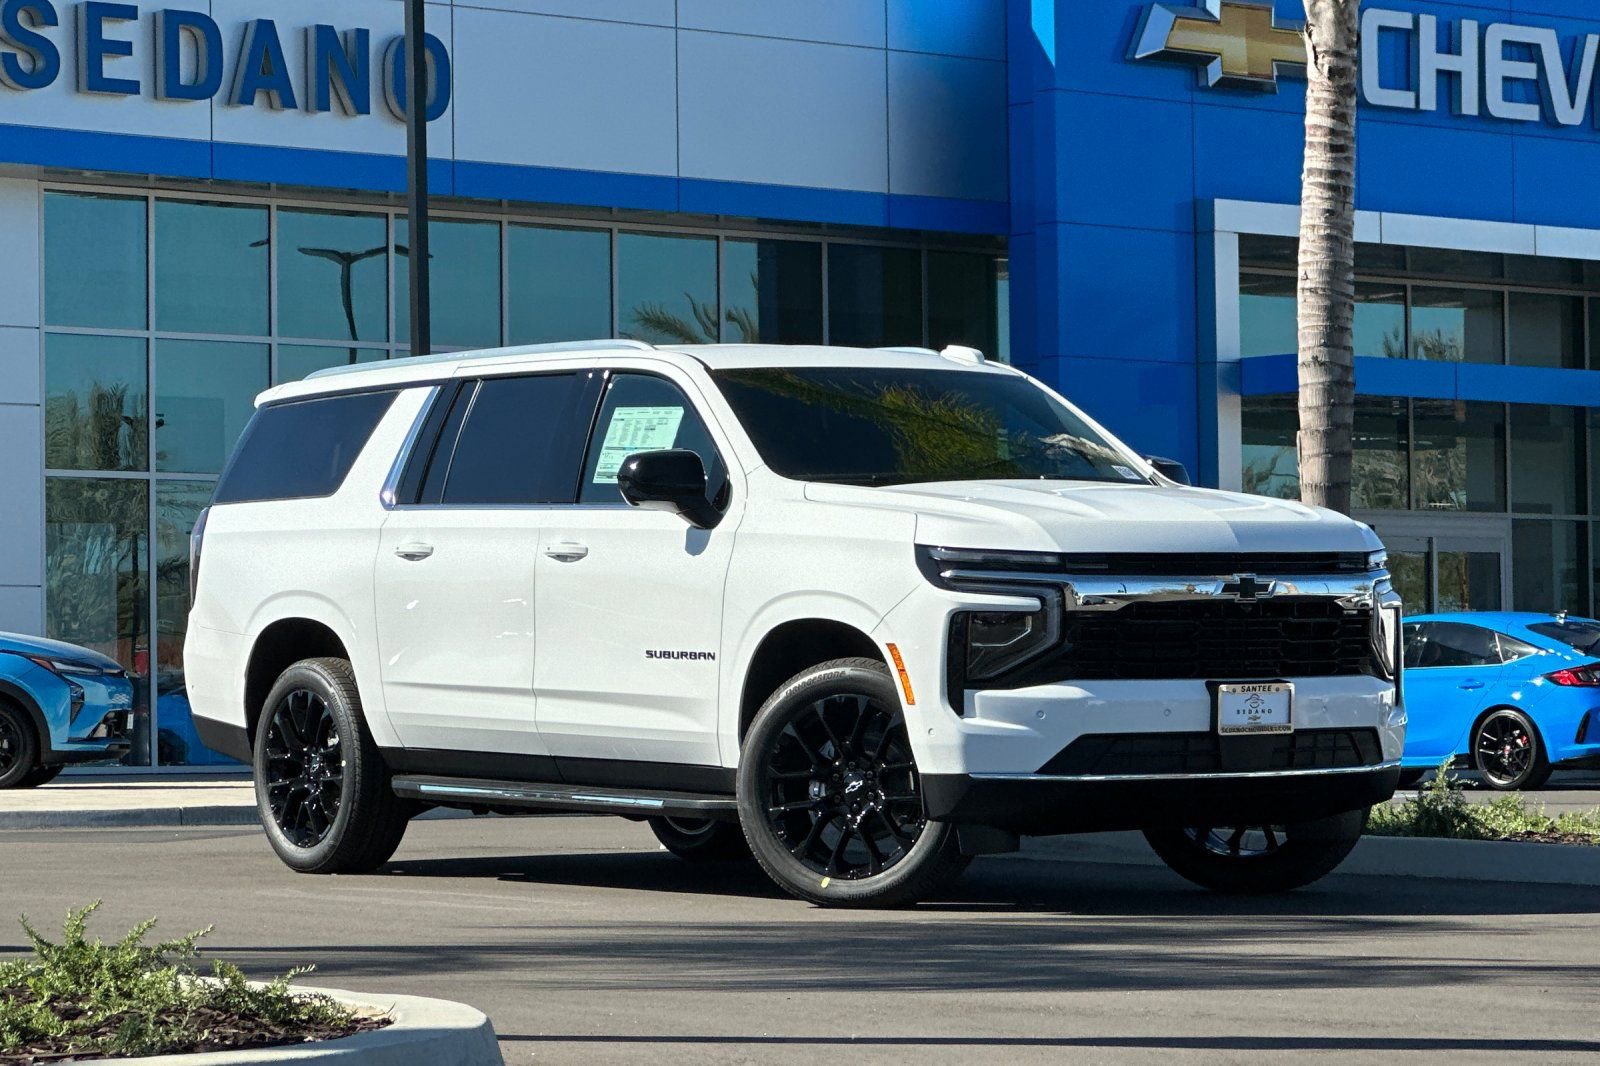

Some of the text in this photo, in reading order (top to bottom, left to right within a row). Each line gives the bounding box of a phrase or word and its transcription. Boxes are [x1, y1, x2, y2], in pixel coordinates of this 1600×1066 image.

[0, 0, 451, 123] SEDANO
[645, 649, 716, 661] SUBURBAN
[1241, 685, 1273, 693] SANTEE
